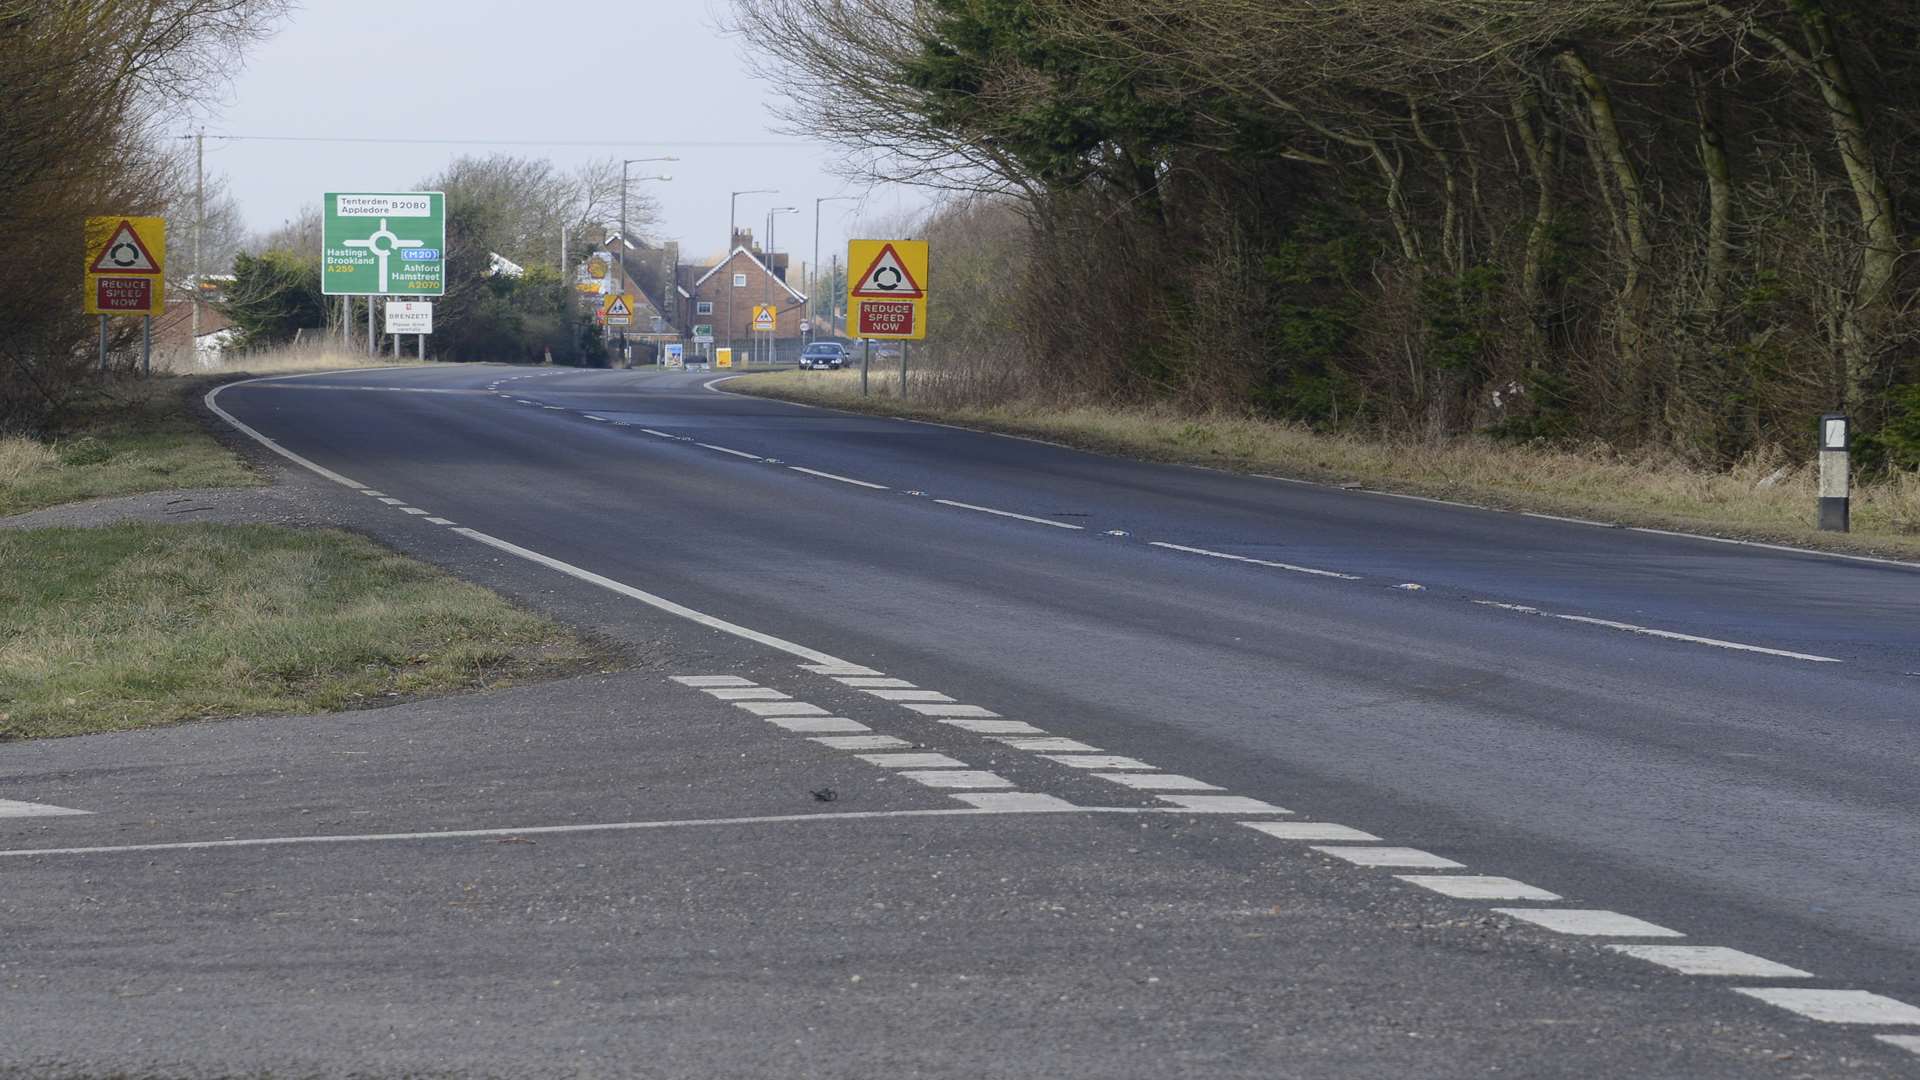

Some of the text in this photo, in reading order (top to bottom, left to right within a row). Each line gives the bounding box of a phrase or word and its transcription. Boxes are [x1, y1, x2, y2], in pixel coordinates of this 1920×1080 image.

[342, 206, 389, 214] Appledore
[328, 249, 367, 258] Hastings
[328, 257, 374, 265] Brookland
[404, 264, 440, 272] Ashford
[392, 272, 440, 280] Hamstreet
[102, 280, 146, 288] REDUCE
[106, 289, 142, 297] SPEED
[864, 305, 909, 313] REDUCE
[868, 314, 905, 322] SPEED
[872, 323, 900, 331] NOW
